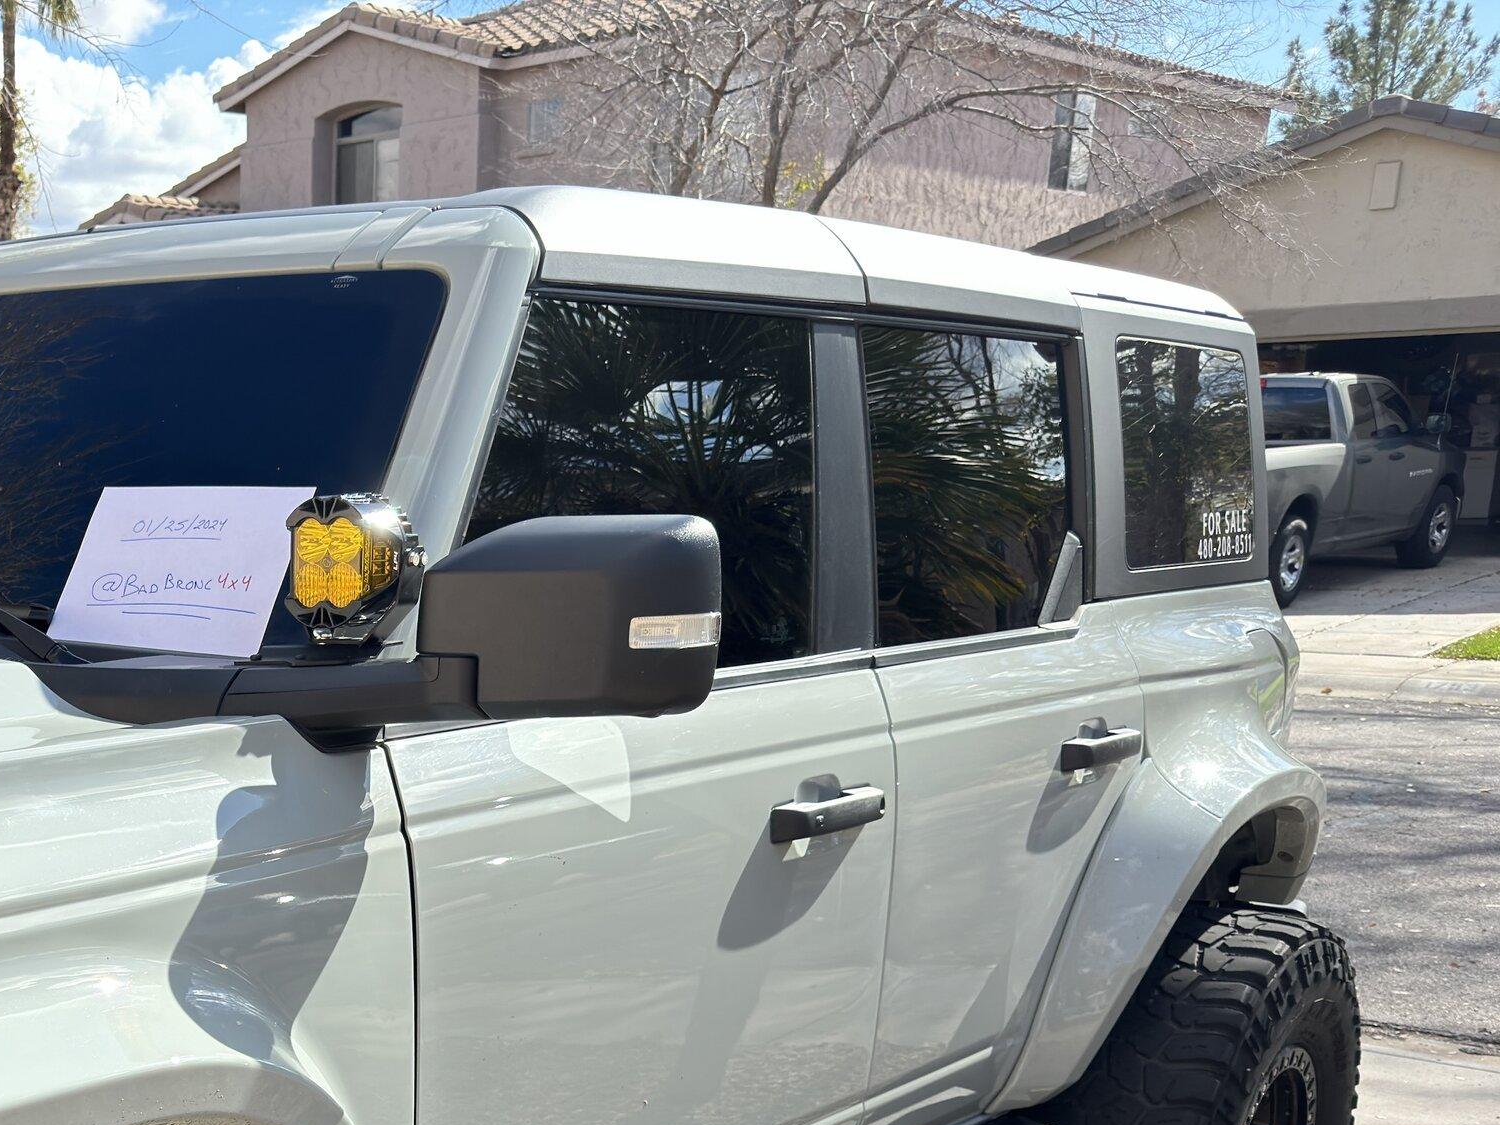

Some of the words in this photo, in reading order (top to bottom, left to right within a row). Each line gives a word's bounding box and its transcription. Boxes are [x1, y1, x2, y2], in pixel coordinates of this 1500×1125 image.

[132, 515, 229, 537] 01/25/2024
[1202, 512, 1222, 536] FOR
[1224, 509, 1247, 534] SALE
[1197, 533, 1253, 560] 480-208-8511
